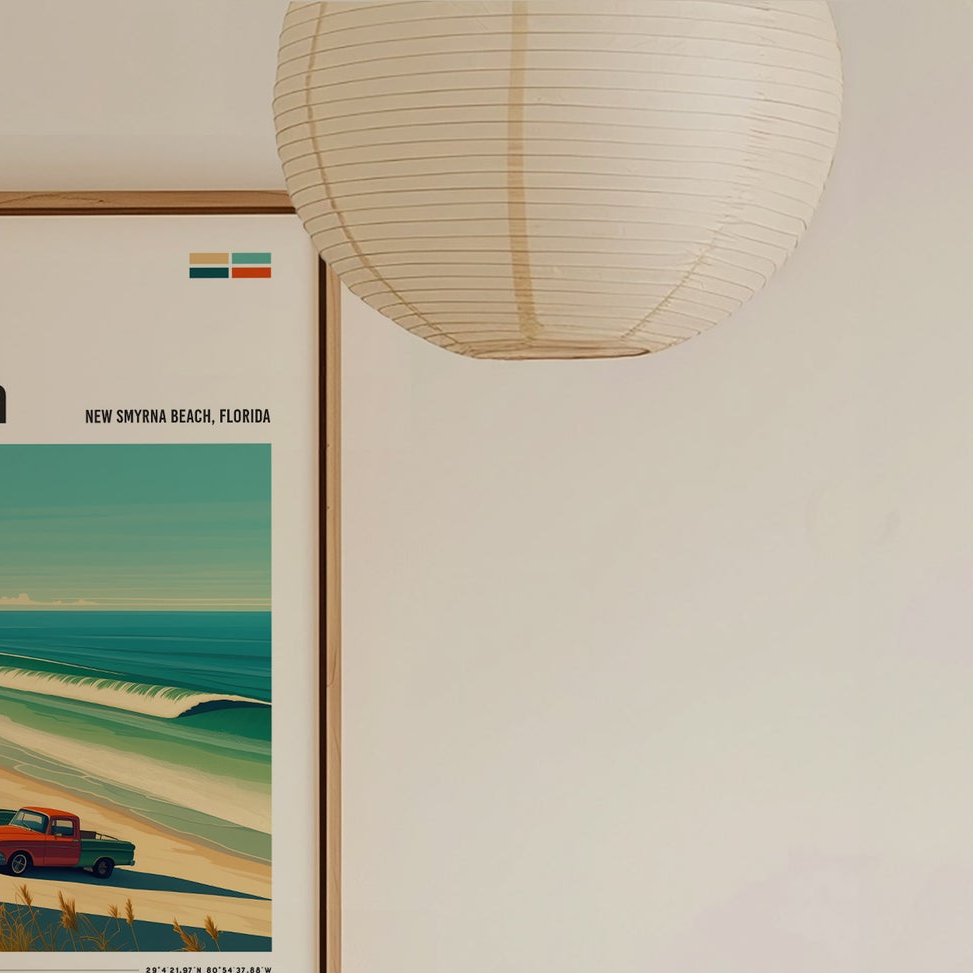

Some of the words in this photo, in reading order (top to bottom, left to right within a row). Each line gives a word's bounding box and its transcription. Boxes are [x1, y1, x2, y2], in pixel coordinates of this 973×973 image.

[85, 409, 113, 424] NEW
[116, 408, 167, 424] SMYRNA
[170, 408, 215, 425] BEACH,
[219, 408, 271, 424] FLORIDA
